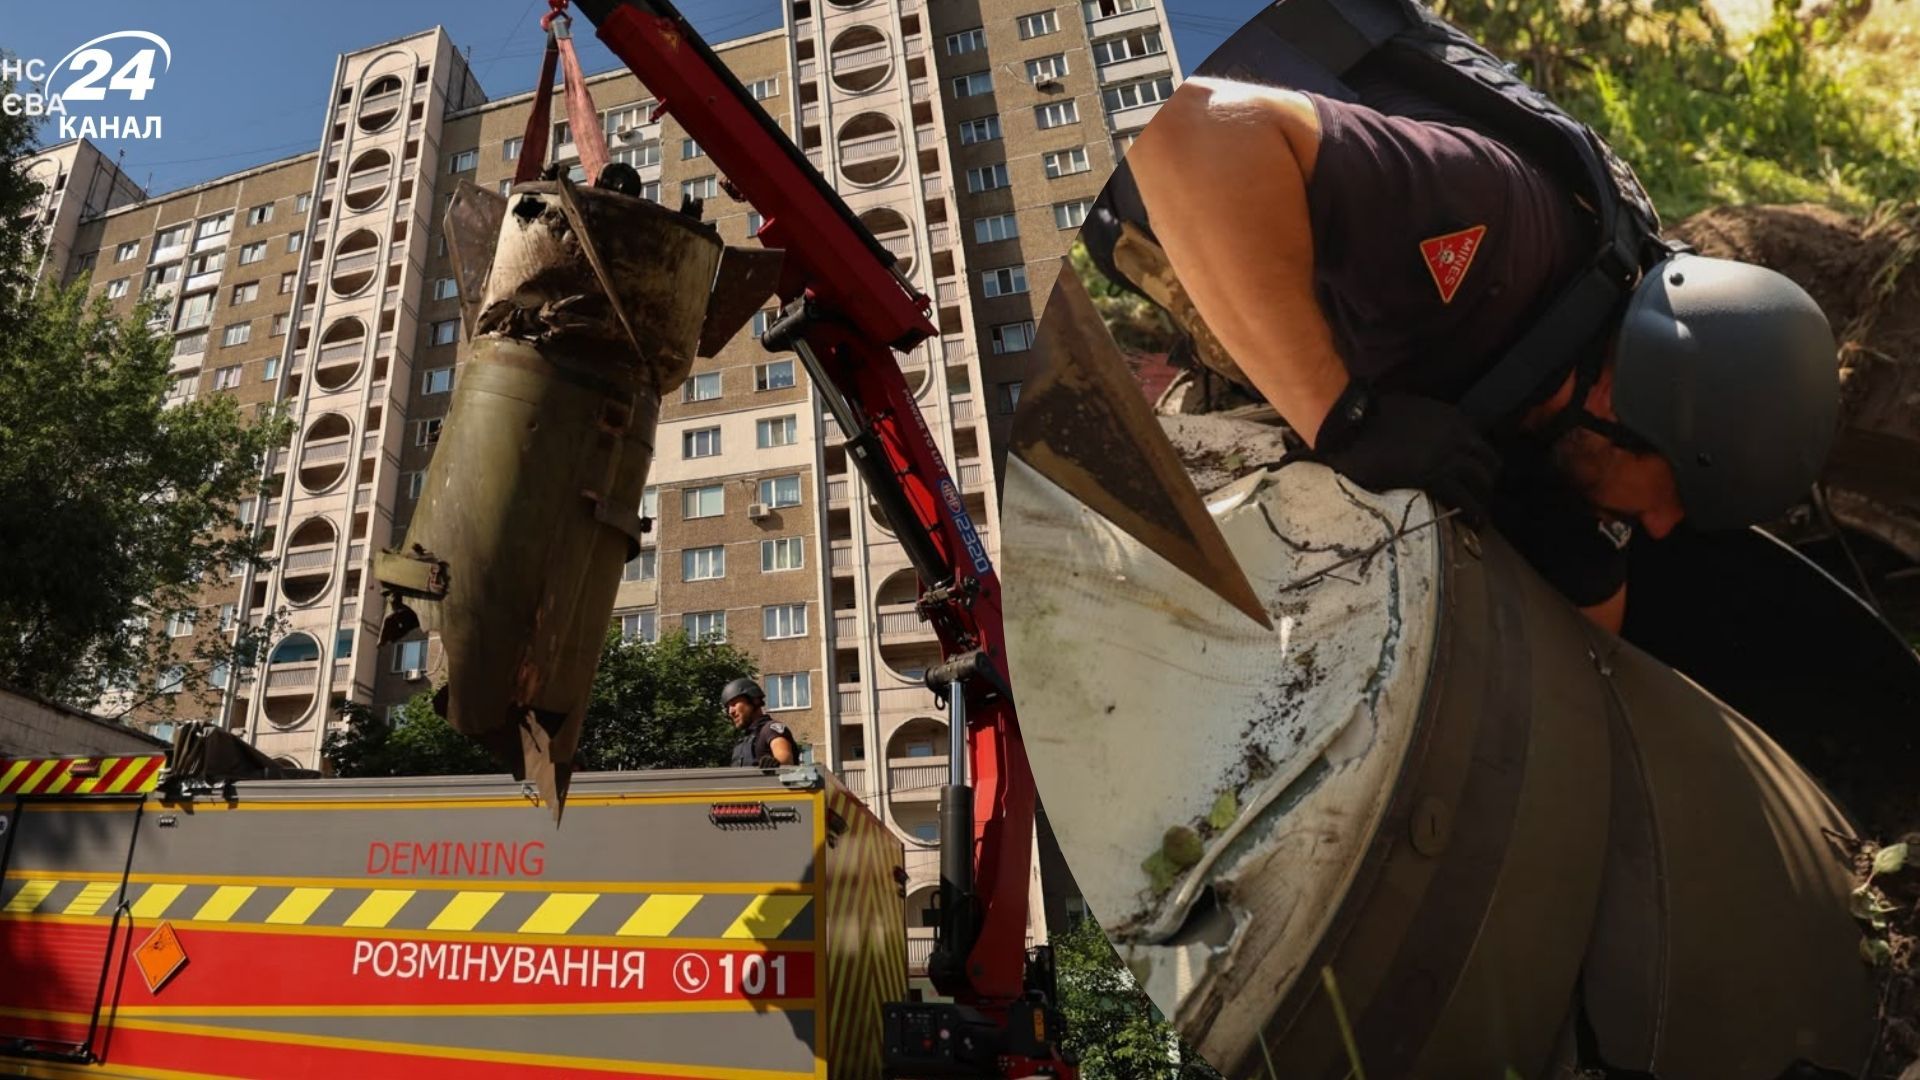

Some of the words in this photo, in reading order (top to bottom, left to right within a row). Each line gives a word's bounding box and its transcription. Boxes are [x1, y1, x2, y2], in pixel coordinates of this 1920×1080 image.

[1444, 237, 1474, 286] MINES
[902, 389, 926, 430] POWER
[923, 433, 934, 448] TO
[931, 450, 947, 473] LIFT
[955, 514, 989, 573] 2320
[367, 840, 546, 877] DEMINING
[352, 939, 645, 990] РОЗМІНУВАННЯ
[718, 953, 786, 996] 101
